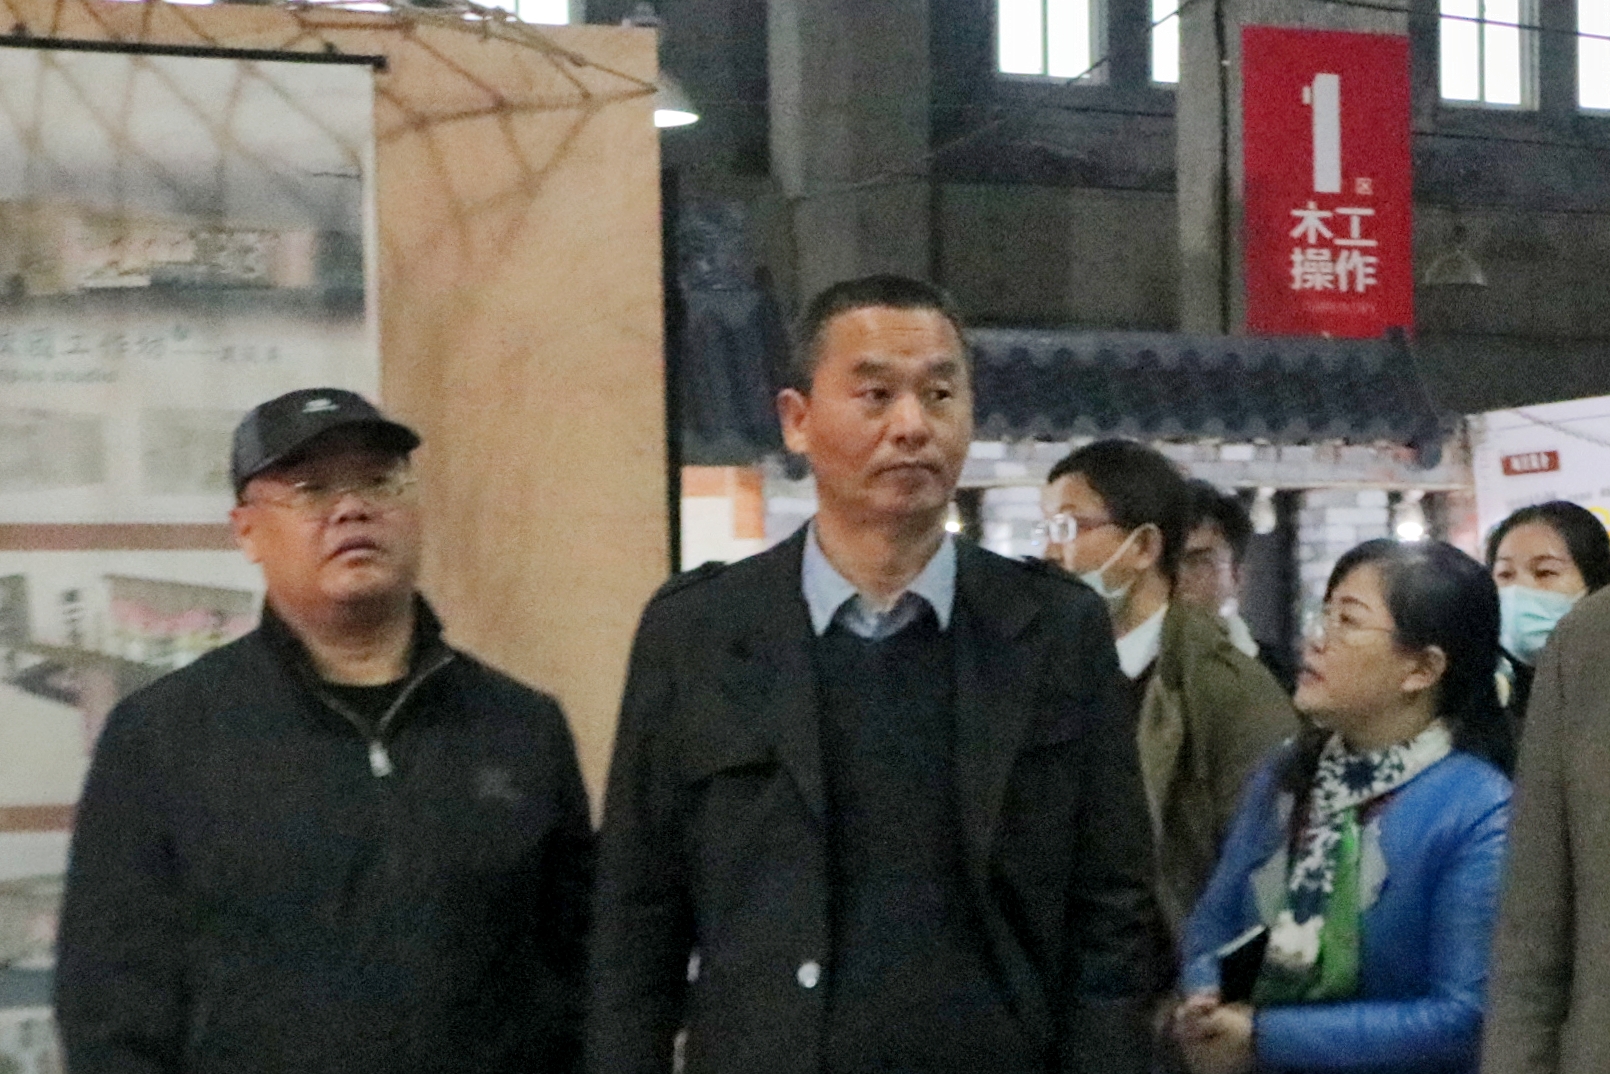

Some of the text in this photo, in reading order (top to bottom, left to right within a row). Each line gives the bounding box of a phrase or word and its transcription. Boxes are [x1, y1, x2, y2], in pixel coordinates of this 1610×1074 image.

[1301, 73, 1341, 193] 1
[1289, 201, 1378, 246] 木工
[1290, 247, 1378, 293] 操作
